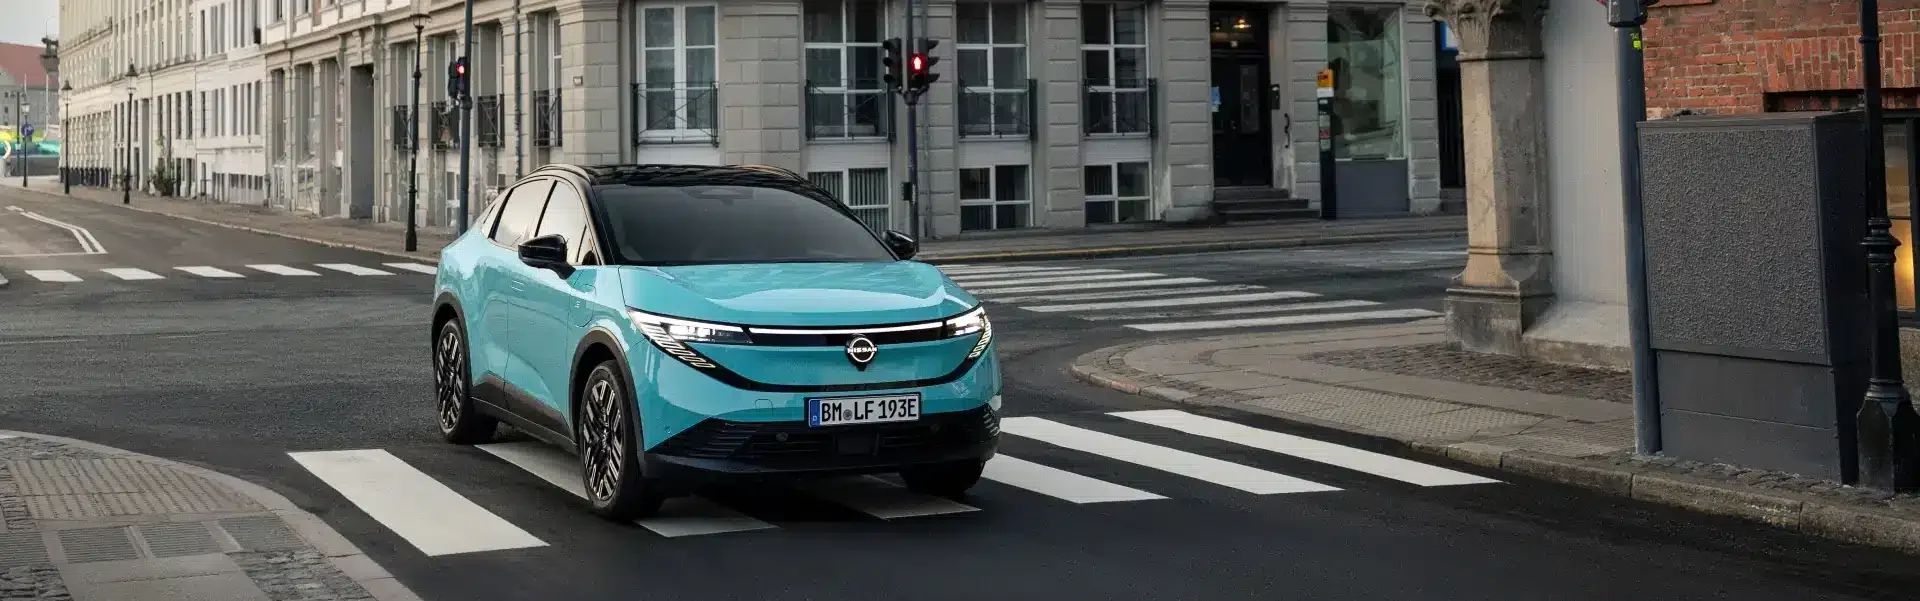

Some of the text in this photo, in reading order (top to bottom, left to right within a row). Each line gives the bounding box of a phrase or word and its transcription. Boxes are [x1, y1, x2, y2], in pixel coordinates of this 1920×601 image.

[847, 346, 878, 354] NISSAN
[821, 398, 917, 422] BM LF 193E
